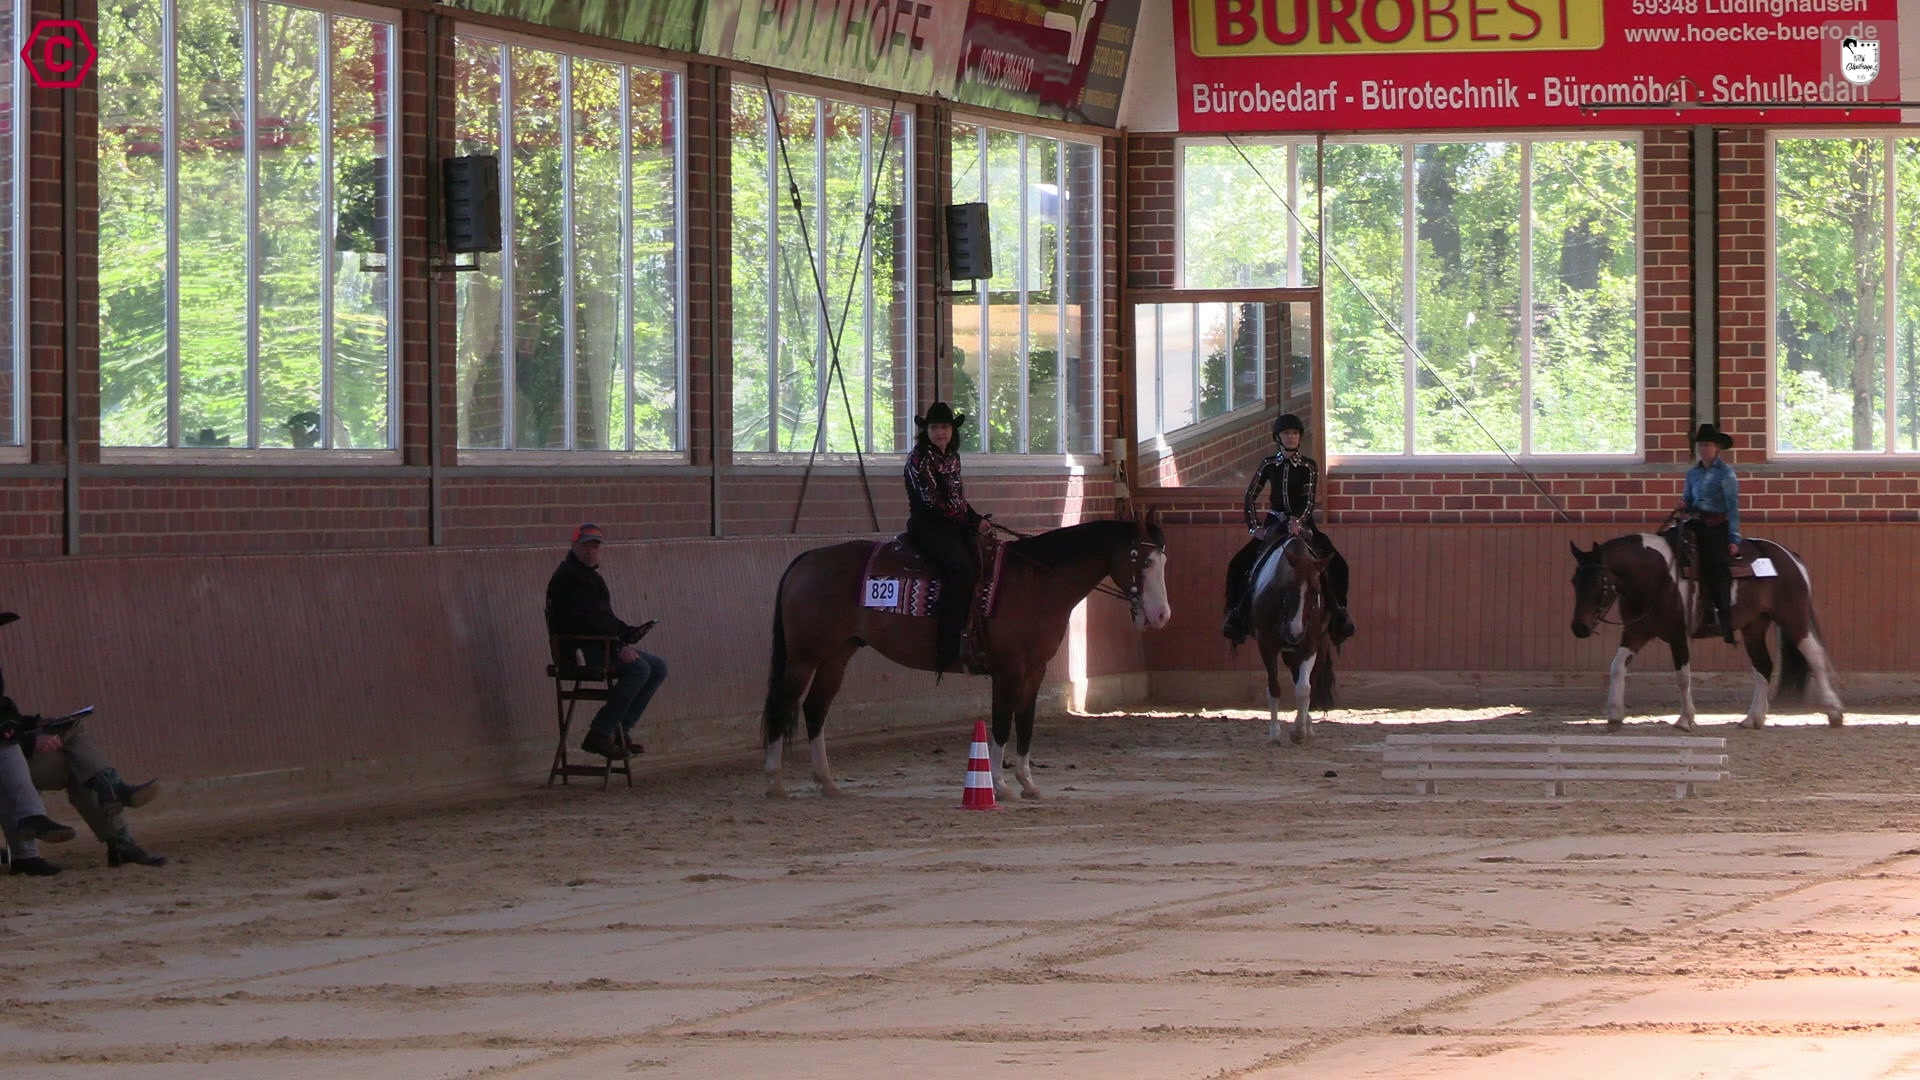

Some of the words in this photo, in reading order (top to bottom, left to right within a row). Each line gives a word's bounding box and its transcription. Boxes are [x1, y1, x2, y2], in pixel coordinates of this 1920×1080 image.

[1632, 0, 1698, 15] 59348
[1624, 22, 1878, 43] www.hoecke-buero.de
[1193, 81, 1338, 114] Bürobedarf
[1361, 78, 1520, 111] Bürotechnik
[1544, 75, 1688, 107] Büromöbel
[1712, 73, 1869, 103] Schulbedarf
[871, 582, 895, 600] 829
